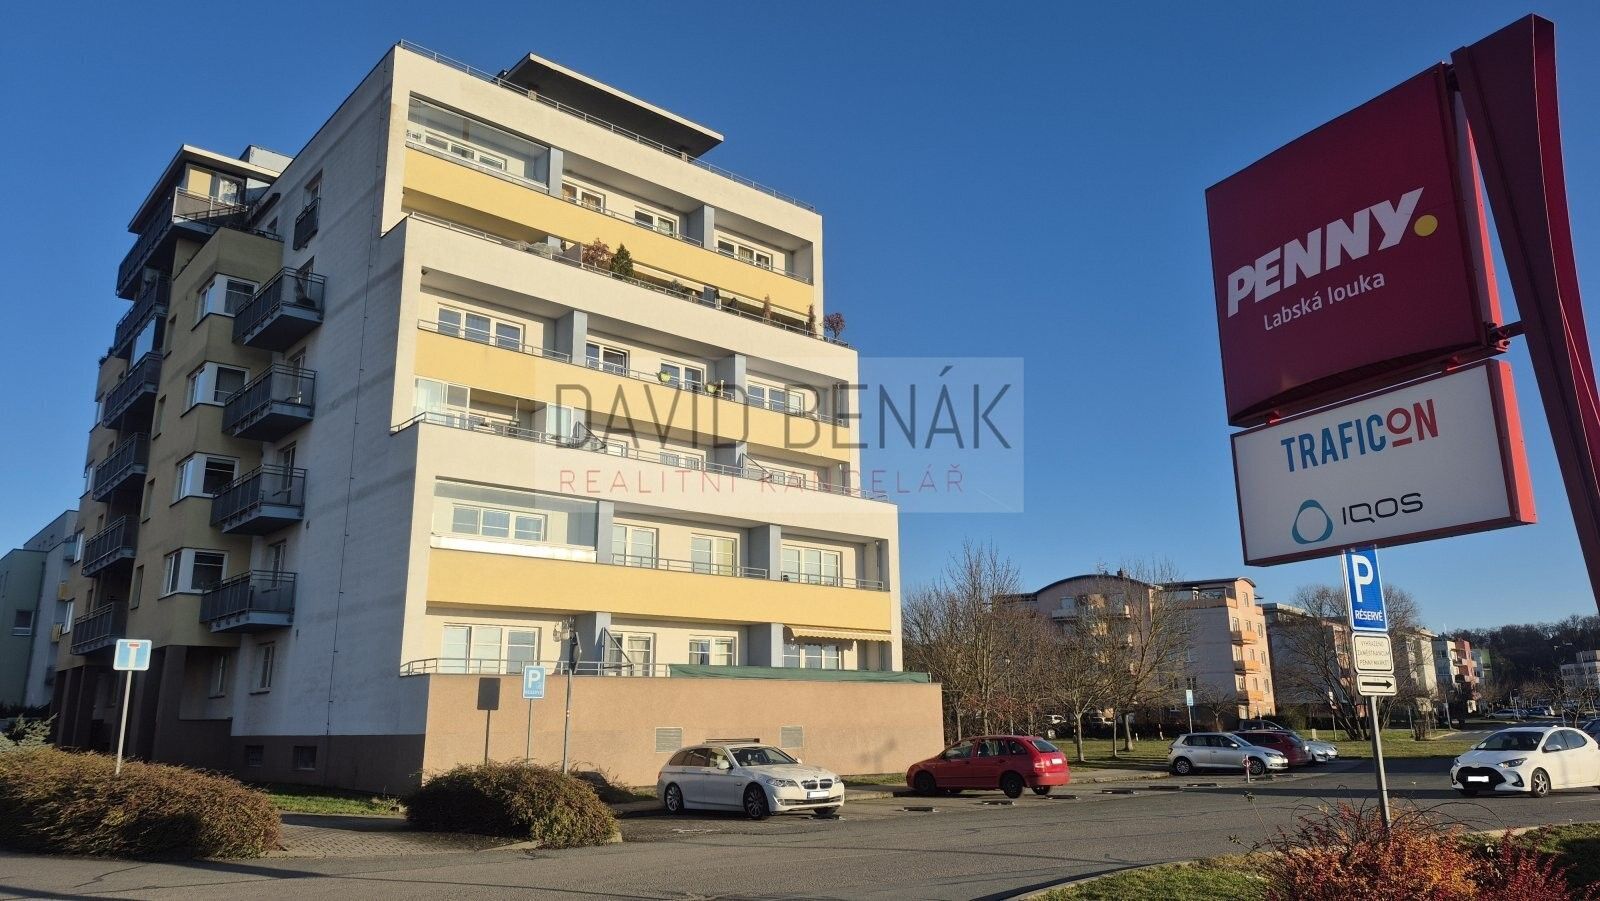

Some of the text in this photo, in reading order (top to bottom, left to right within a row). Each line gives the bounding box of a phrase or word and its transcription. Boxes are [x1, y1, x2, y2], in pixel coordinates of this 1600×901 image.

[1264, 271, 1385, 331] Labská louka
[1281, 399, 1439, 472] TRAFICON
[1342, 492, 1424, 525] IQOS
[1351, 554, 1374, 603] P
[529, 670, 541, 688] P
